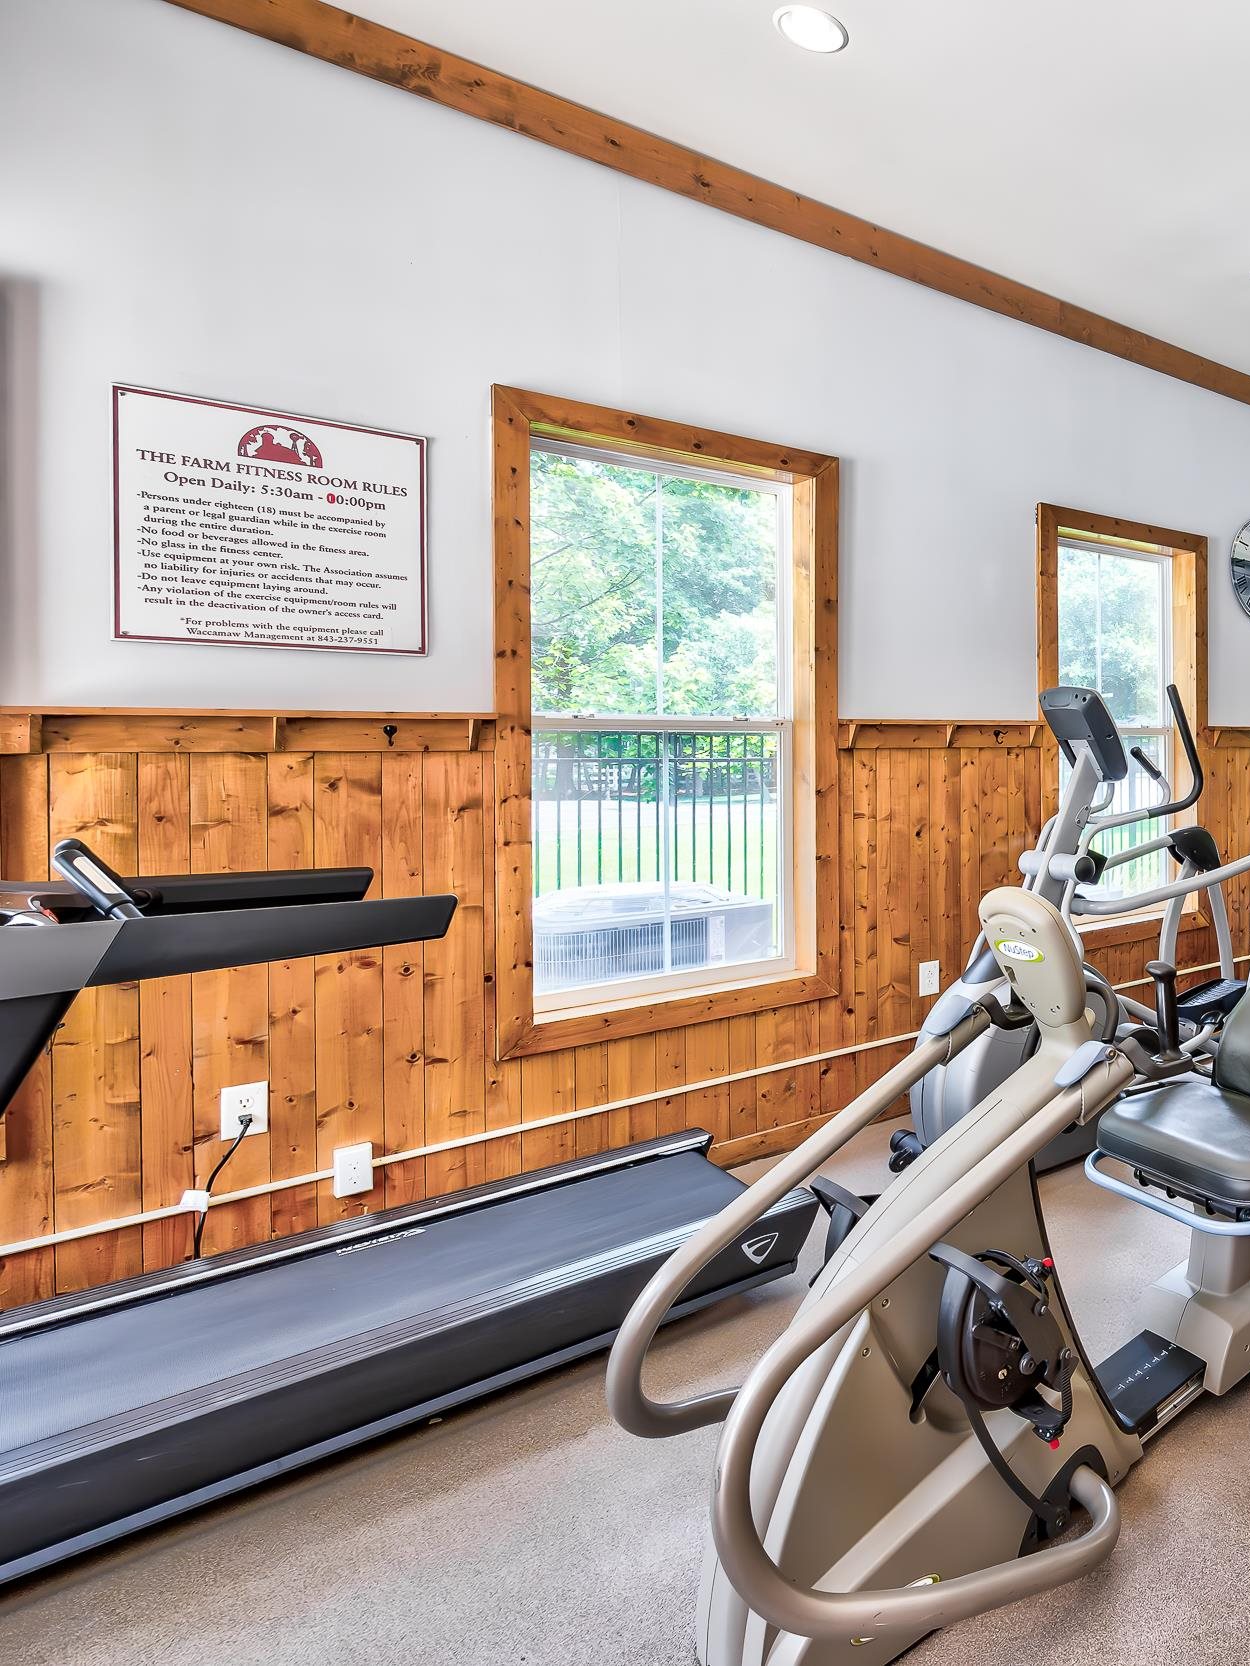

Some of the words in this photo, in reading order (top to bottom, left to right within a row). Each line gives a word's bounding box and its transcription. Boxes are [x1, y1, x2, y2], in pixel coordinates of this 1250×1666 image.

[136, 448, 177, 465] THE
[181, 455, 232, 473] FARM
[236, 463, 303, 483] FITNESS
[307, 473, 359, 491] ROOM
[362, 481, 408, 498] RULES
[164, 471, 206, 487] Open
[211, 477, 256, 495] Daily:
[260, 484, 314, 501] 5:30am
[143, 514, 178, 528] during
[181, 518, 197, 528] the
[199, 522, 228, 531] entire
[229, 524, 274, 536] duration.
[153, 506, 186, 515] parent
[202, 509, 226, 521] legal
[228, 515, 271, 525] guardian
[273, 518, 299, 528] while
[300, 521, 310, 530] in
[312, 523, 327, 532] the
[328, 526, 362, 536] exercise
[364, 531, 387, 539] room
[182, 497, 212, 507] under
[214, 500, 255, 512] eighteen
[257, 505, 277, 516] (18)
[279, 510, 302, 518] must
[303, 511, 315, 519] be
[317, 515, 373, 527] accompanied
[375, 520, 386, 530] by
[161, 527, 185, 538] food
[202, 532, 249, 545] beverages
[251, 538, 288, 549] allowed
[290, 541, 300, 550] in
[302, 543, 317, 552] the
[318, 544, 347, 555] fitness
[161, 539, 186, 549] glass
[188, 542, 199, 550] in
[201, 543, 217, 552] the
[220, 545, 251, 556] fitness
[252, 550, 284, 559] center.
[161, 562, 200, 575] liability
[202, 565, 218, 575] for
[219, 567, 256, 578] injuries
[271, 573, 313, 583] accidents
[315, 576, 333, 585] that
[335, 580, 354, 588] may
[163, 552, 217, 564] equipment
[232, 559, 255, 567] your
[280, 562, 301, 571] risk.
[302, 564, 321, 573] The
[323, 566, 373, 578] Association
[375, 573, 408, 582] assumes
[181, 575, 207, 585] leave
[209, 579, 260, 590] equipment
[263, 582, 292, 594] laying
[293, 587, 329, 595] around.
[144, 596, 173, 605] result
[176, 597, 187, 606] in
[189, 599, 205, 607] the
[207, 600, 267, 612] deactivation
[268, 605, 280, 613] of
[281, 605, 296, 614] the
[298, 608, 333, 617] owner's
[334, 611, 361, 619] access
[362, 612, 384, 620] card.
[165, 586, 211, 597] violation
[213, 589, 225, 598] of
[227, 590, 242, 599] the
[244, 593, 282, 602] exercise
[284, 596, 357, 608] equipment/room
[359, 601, 380, 609] rules
[381, 603, 397, 611] will
[186, 627, 241, 637] Waccamaw
[244, 630, 304, 641] Management
[317, 635, 378, 645] 843-237-9551
[205, 619, 250, 629] problems
[252, 622, 273, 630] with
[276, 623, 291, 631] the
[292, 625, 340, 634] equipment
[341, 627, 368, 636] please
[1003, 943, 1034, 959] NuStep
